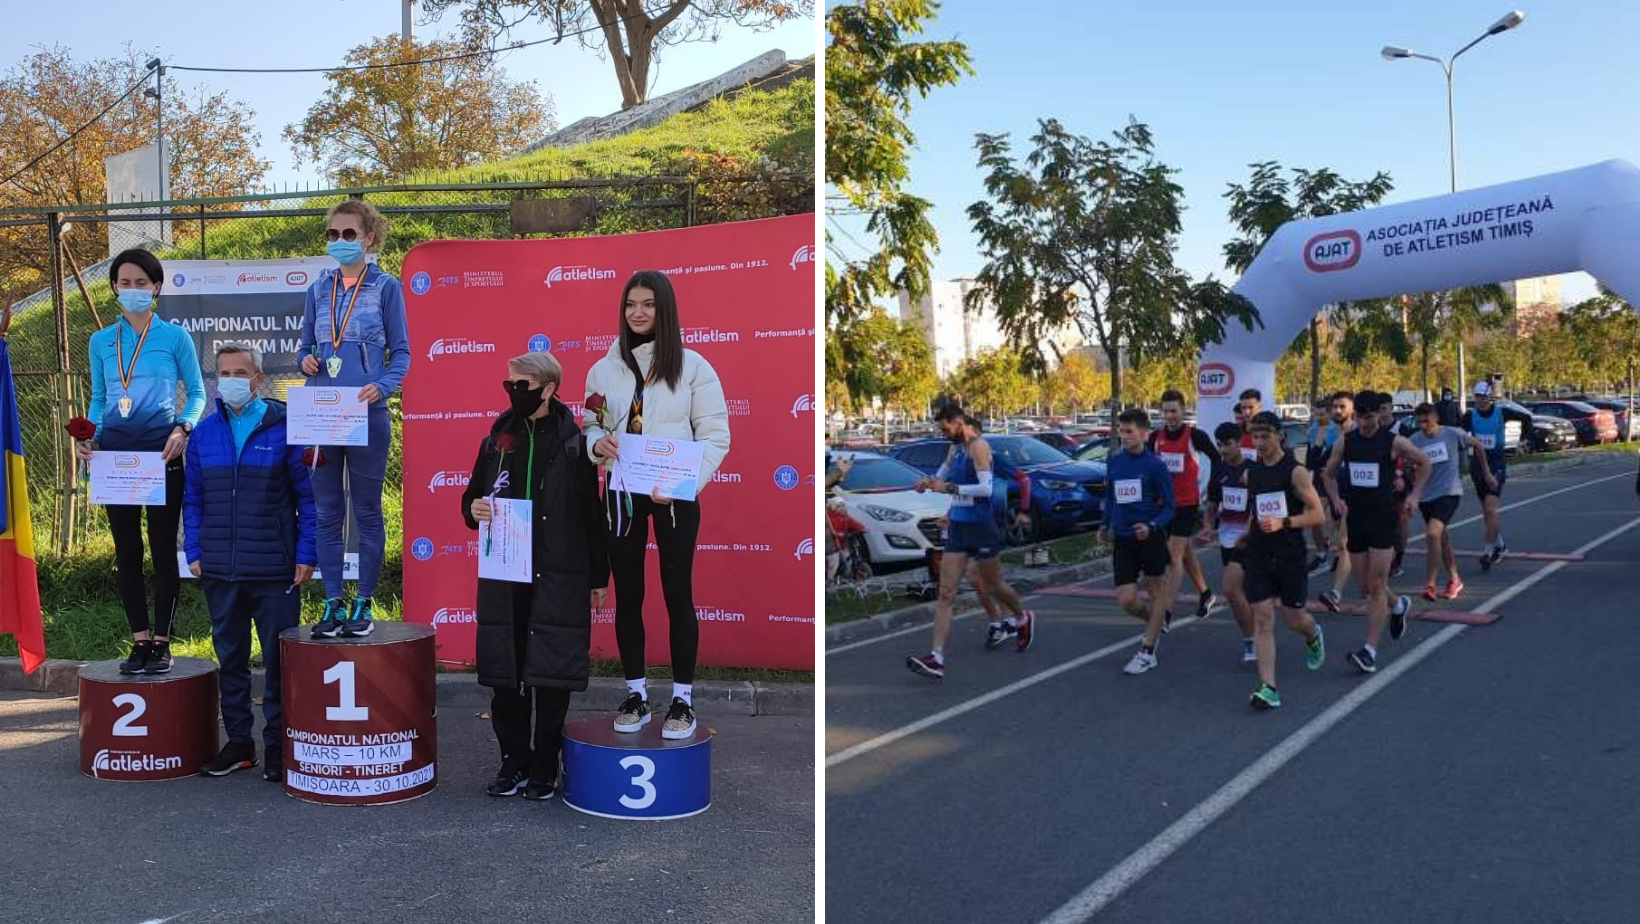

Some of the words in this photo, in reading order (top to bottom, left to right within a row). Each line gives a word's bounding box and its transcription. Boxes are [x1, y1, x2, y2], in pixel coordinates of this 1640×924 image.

[1366, 219, 1448, 242] ASOCIAȚIA
[1452, 196, 1554, 227] JUDEȚEANĂ
[1384, 244, 1404, 257] DE
[1407, 228, 1485, 254] ATLETISM
[1491, 220, 1534, 240] TIMIȘ
[1315, 240, 1351, 260] AJAT
[563, 267, 616, 281] atletism
[694, 264, 728, 274] pasiune.
[730, 261, 744, 270] Din
[746, 259, 769, 268] 1912.
[246, 273, 278, 284] atletism
[686, 329, 739, 344] atletism
[444, 340, 495, 354] atletism
[402, 411, 443, 420] erformanță
[453, 411, 485, 420] pasiune.
[487, 410, 500, 418] Din
[446, 474, 471, 486] atle
[711, 470, 742, 483] tism
[733, 543, 747, 551] Din
[749, 543, 773, 551] 1912.
[449, 610, 477, 623] atlet
[696, 608, 745, 622] tletism
[769, 614, 816, 624] Performanț
[323, 660, 369, 721] 1
[112, 693, 148, 736] 2
[286, 727, 360, 746] CAMPIONATUL
[301, 744, 340, 762] MARȘ
[359, 747, 375, 760] 10
[380, 744, 401, 759] KM
[110, 754, 182, 771] atletism
[299, 761, 343, 776] SENIORI
[353, 761, 405, 777] TINERET
[290, 771, 361, 793] TIMIȘOARA
[374, 767, 433, 793] 30.10.2021
[618, 755, 657, 810] 3
